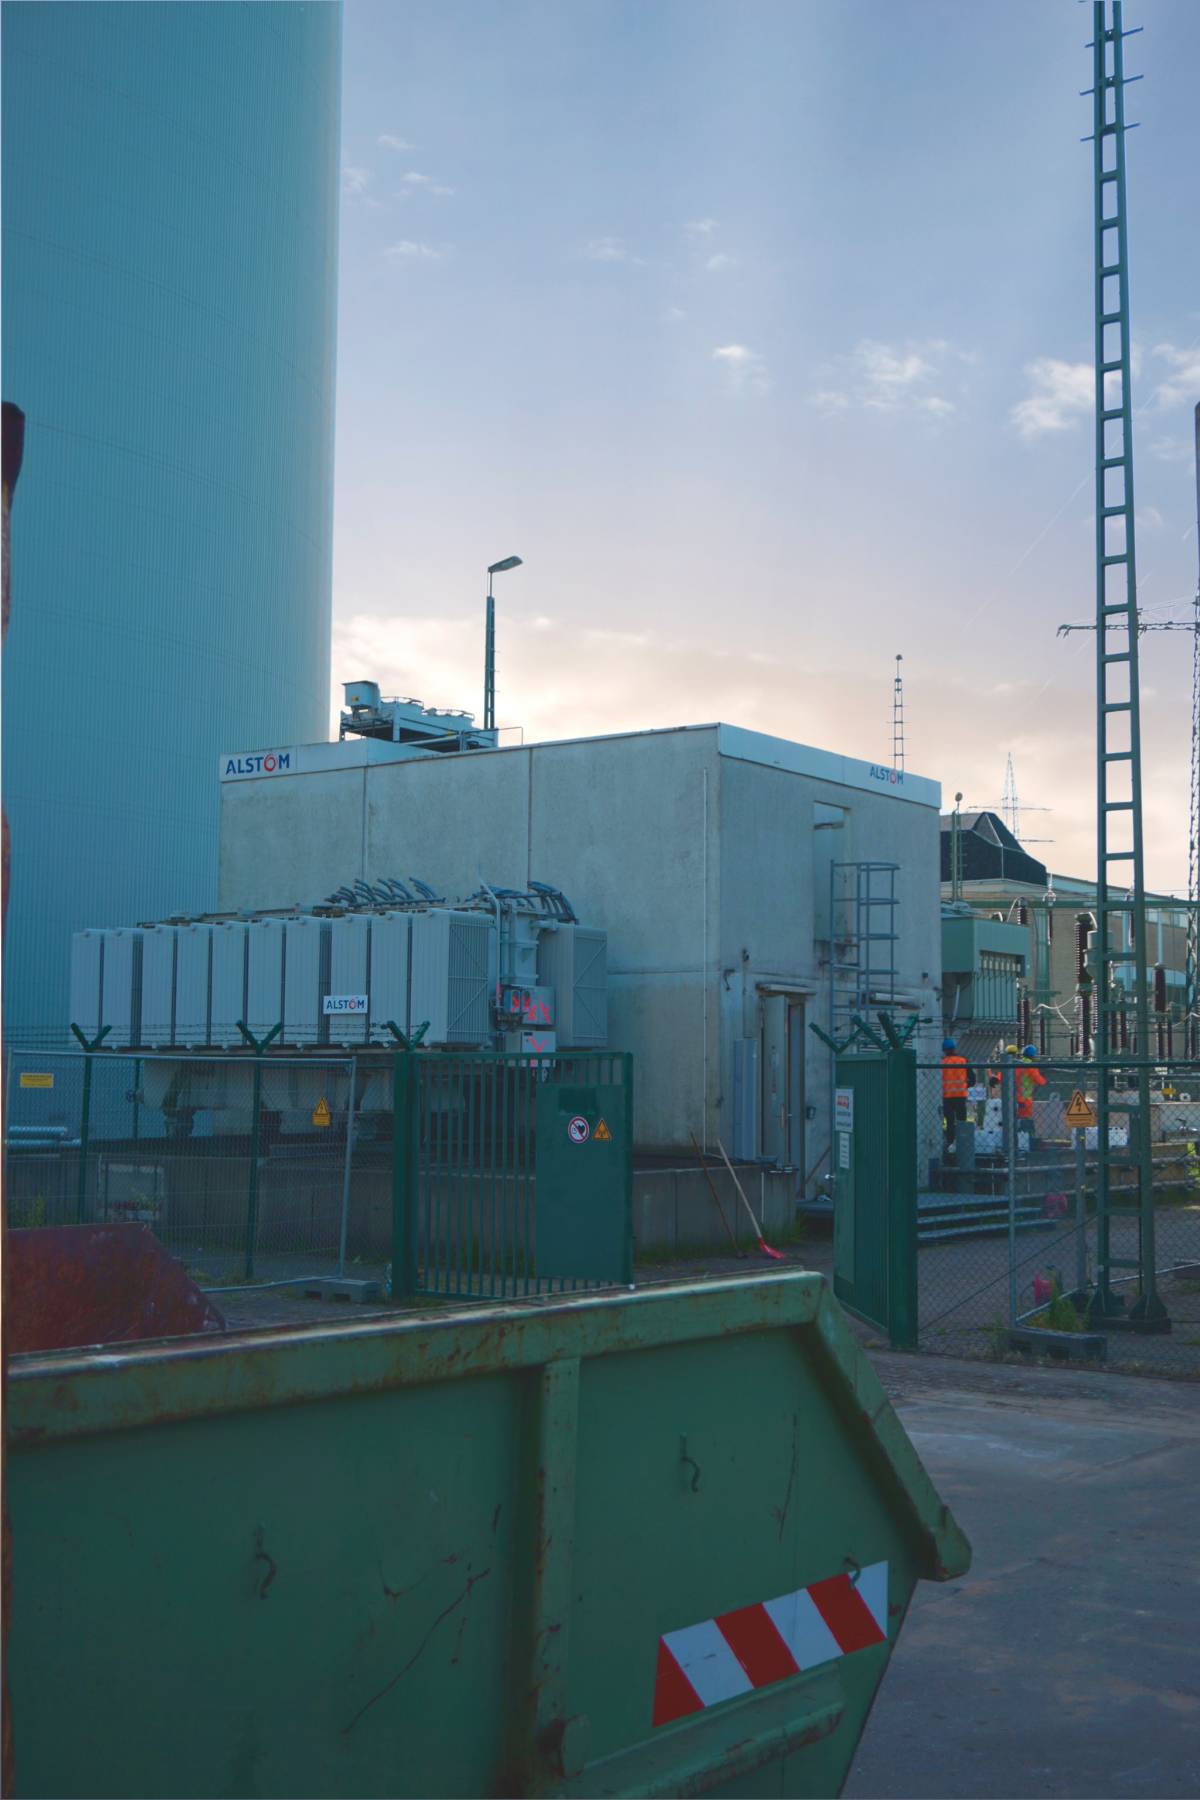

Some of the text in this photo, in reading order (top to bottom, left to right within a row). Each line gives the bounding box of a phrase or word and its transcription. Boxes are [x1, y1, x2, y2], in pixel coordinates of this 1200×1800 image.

[225, 753, 290, 775] ALSTOM
[870, 766, 904, 785] ALSTOM
[326, 999, 365, 1009] ALSTOM
